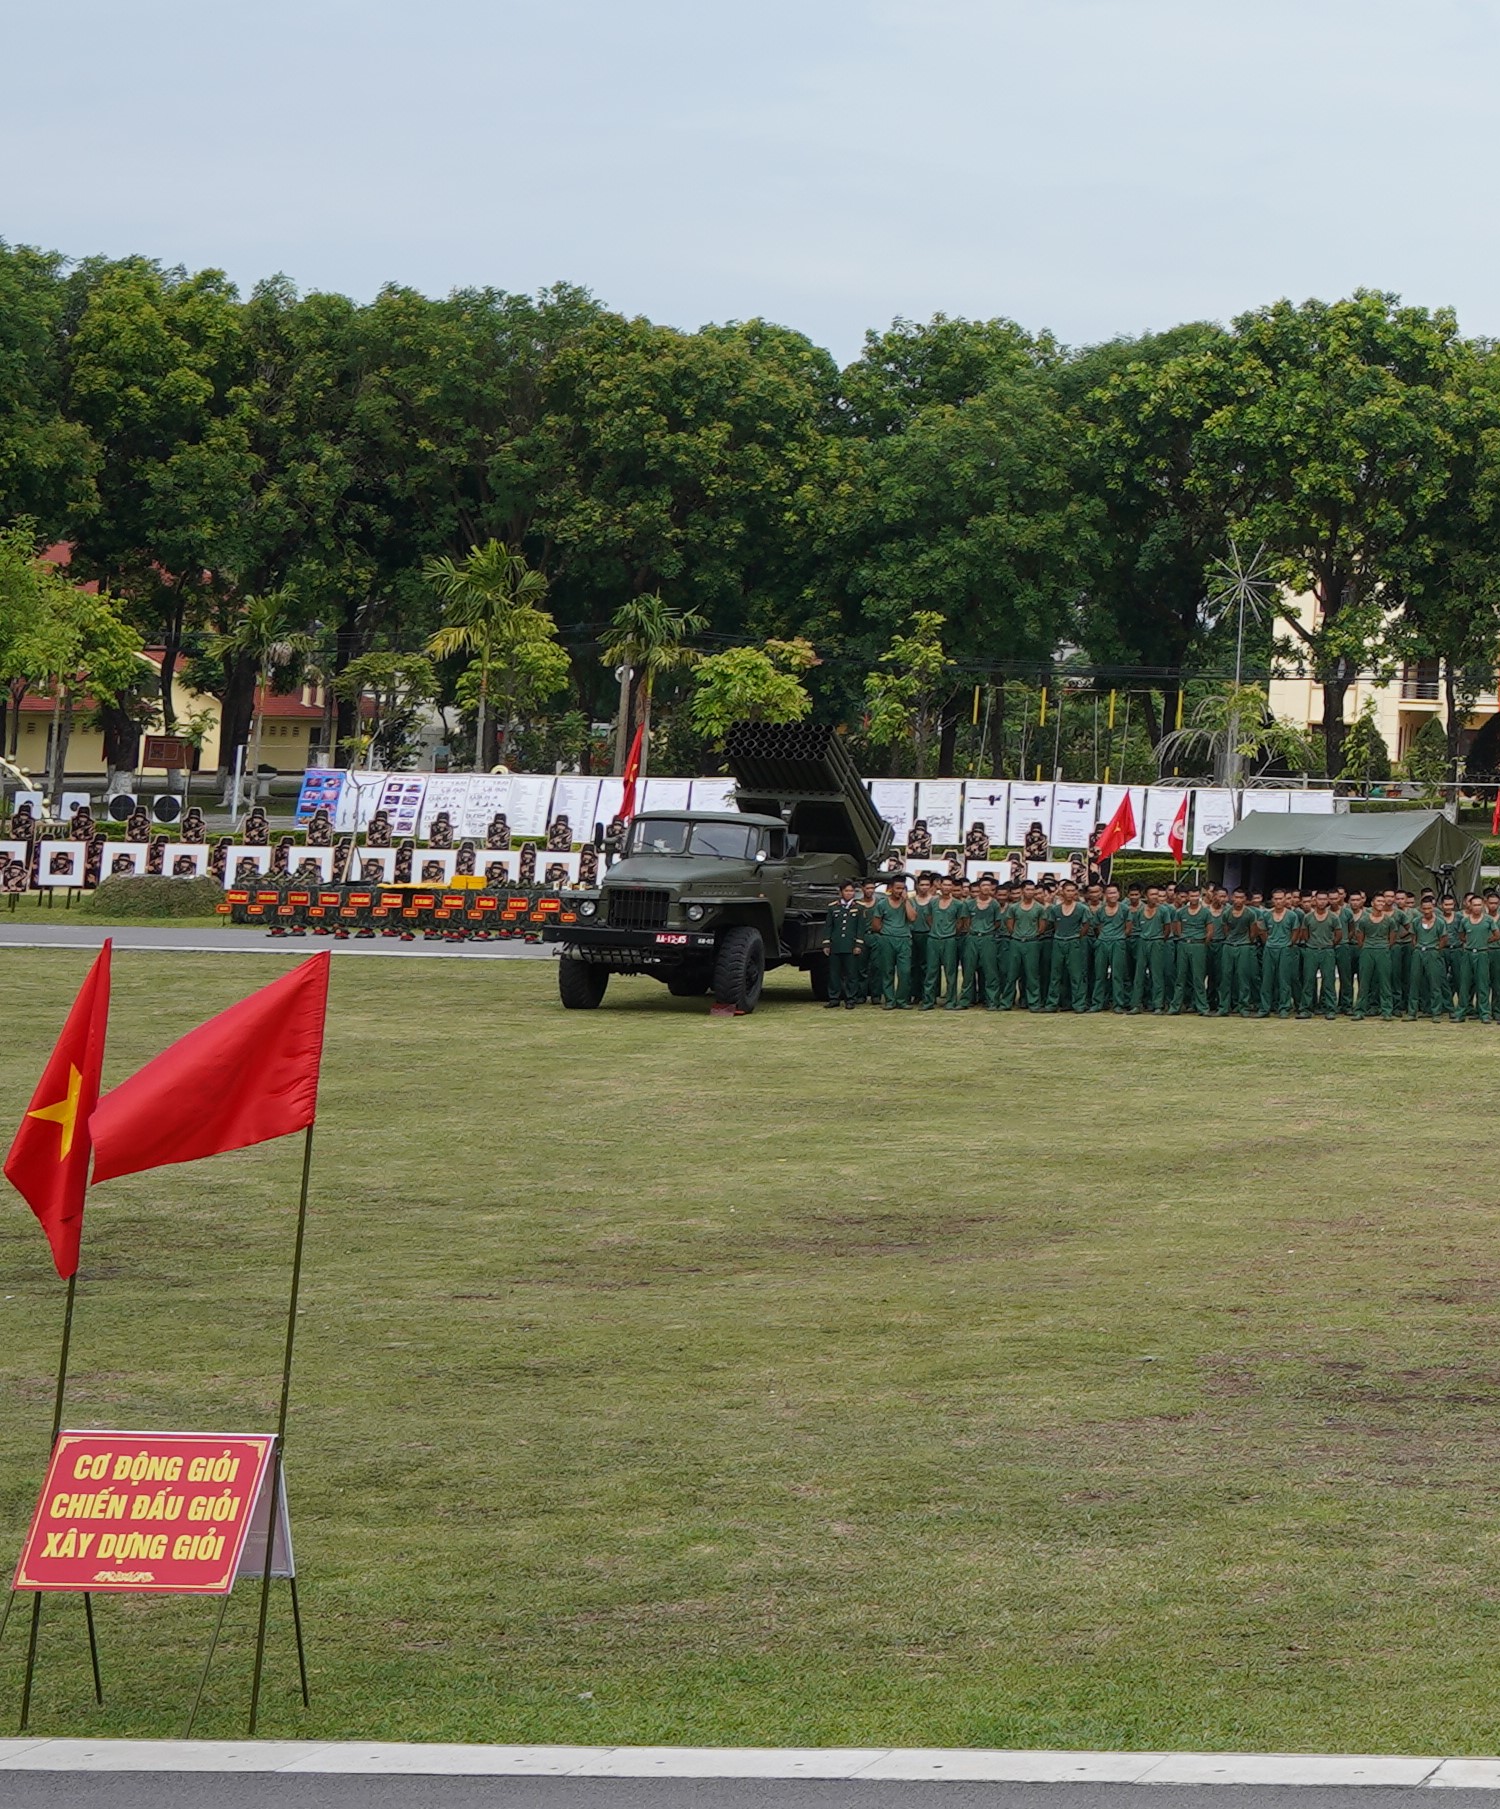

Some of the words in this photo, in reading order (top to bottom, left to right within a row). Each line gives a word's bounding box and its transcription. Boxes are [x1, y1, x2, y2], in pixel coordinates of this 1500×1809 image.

[74, 1453, 112, 1479] CƠ
[111, 1452, 183, 1485] ĐỘNG
[188, 1451, 240, 1482] GIỎI
[50, 1487, 128, 1519] CHIẾN
[131, 1488, 184, 1520] ĐẤU
[188, 1489, 240, 1521] GIỎI
[41, 1529, 95, 1557] XÂY
[97, 1532, 168, 1564] DỰNG
[173, 1528, 225, 1560] GIỎI
